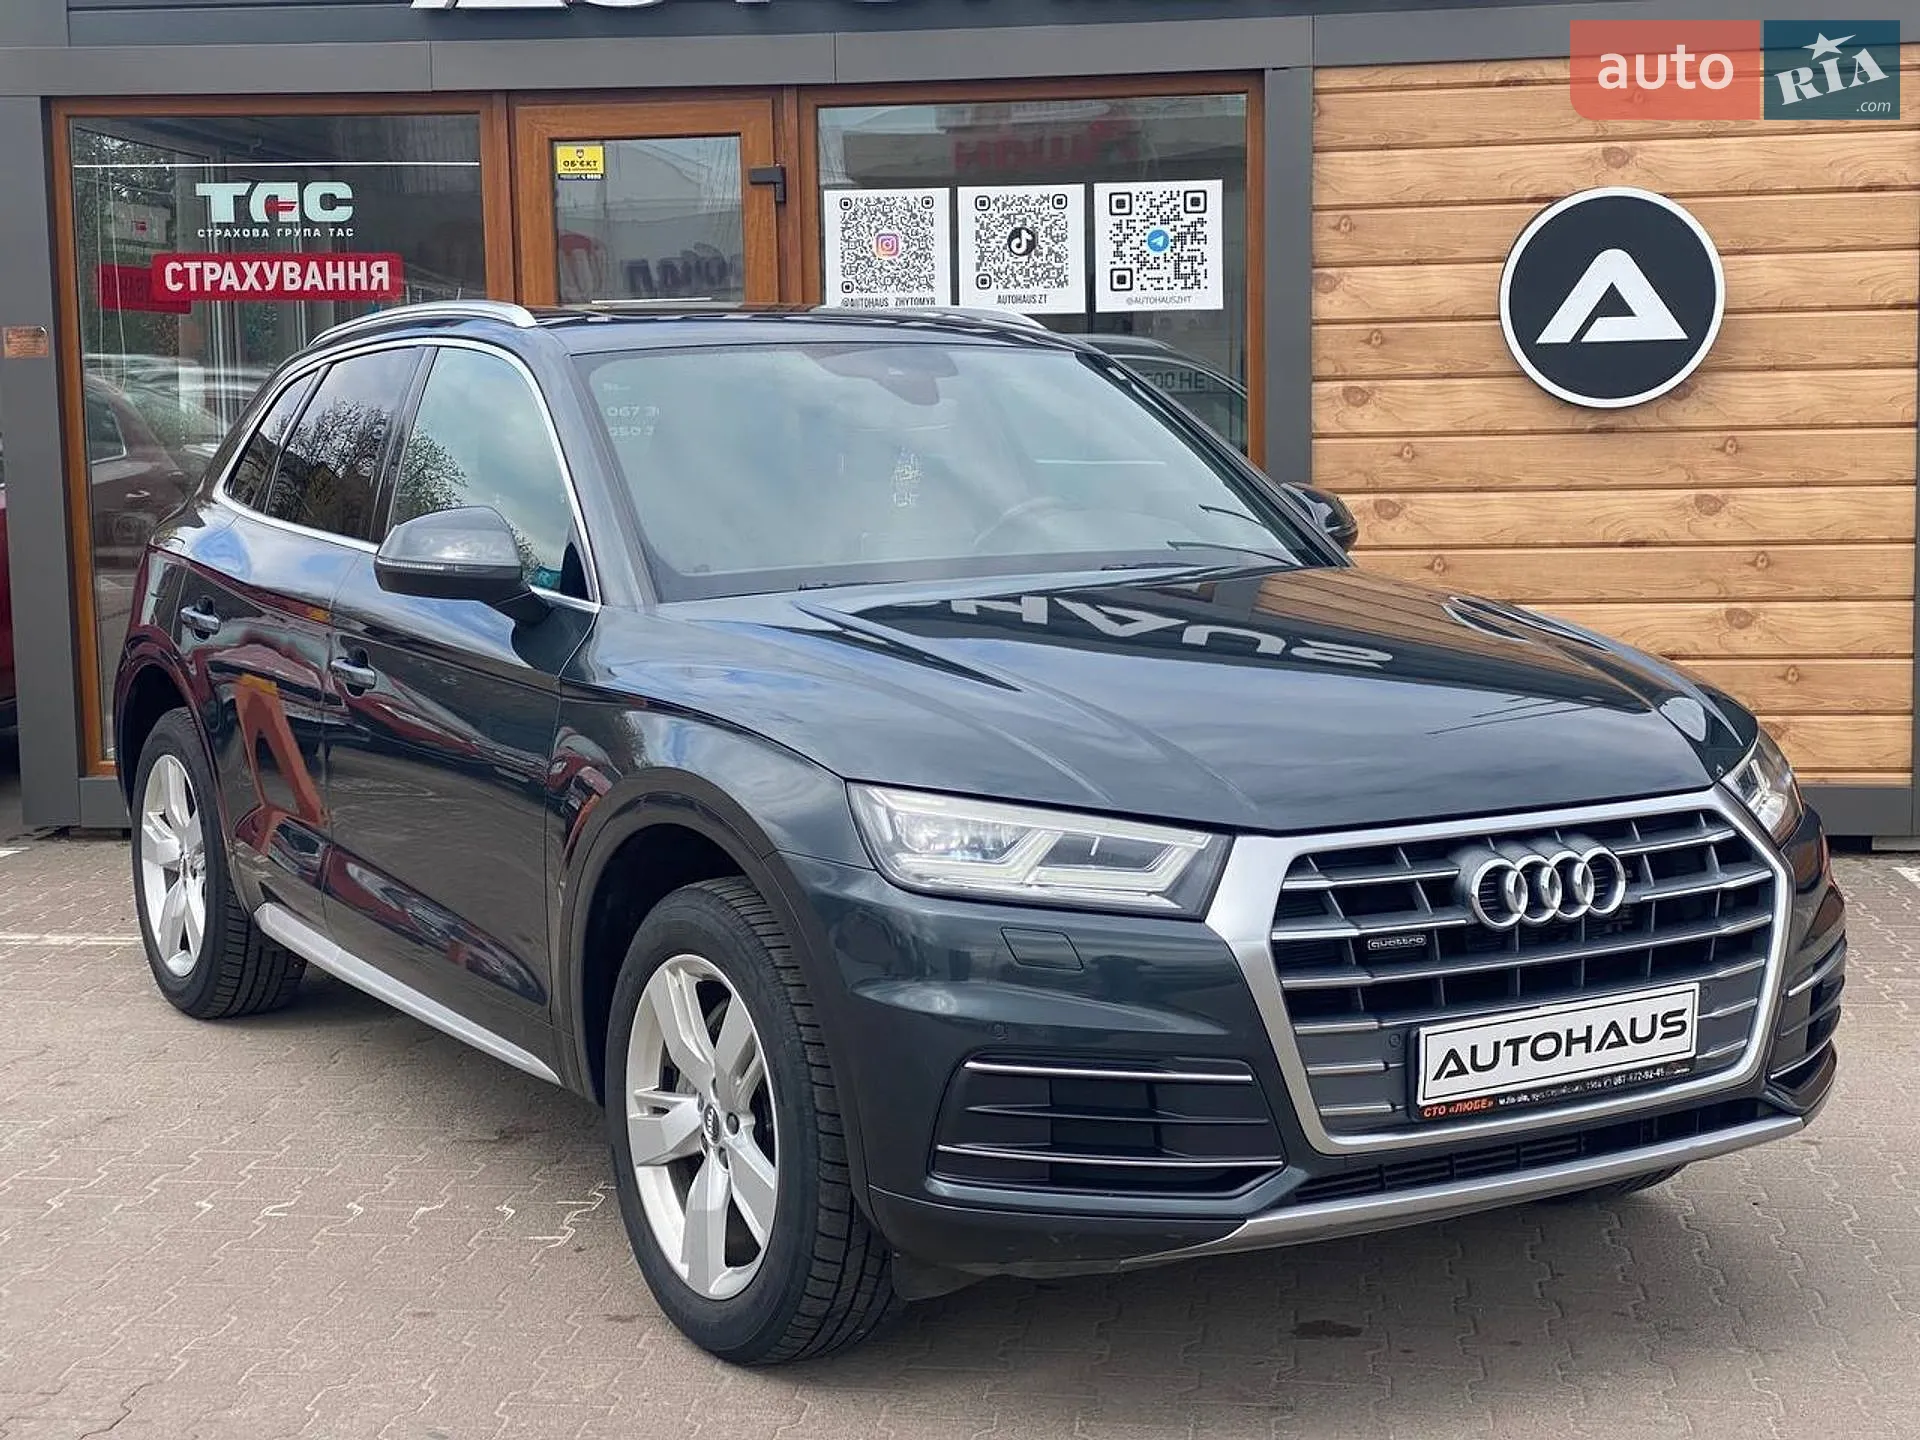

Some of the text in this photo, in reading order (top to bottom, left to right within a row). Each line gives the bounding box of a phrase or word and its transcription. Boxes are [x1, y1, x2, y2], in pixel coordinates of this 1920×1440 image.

[197, 227, 354, 238] СТРАХОВА ГРУПА ТАС
[164, 260, 390, 292] СТРАХУВАННЯ
[1433, 1008, 1687, 1081] AUTOHAUS
[1423, 1105, 1447, 1118] СТО
